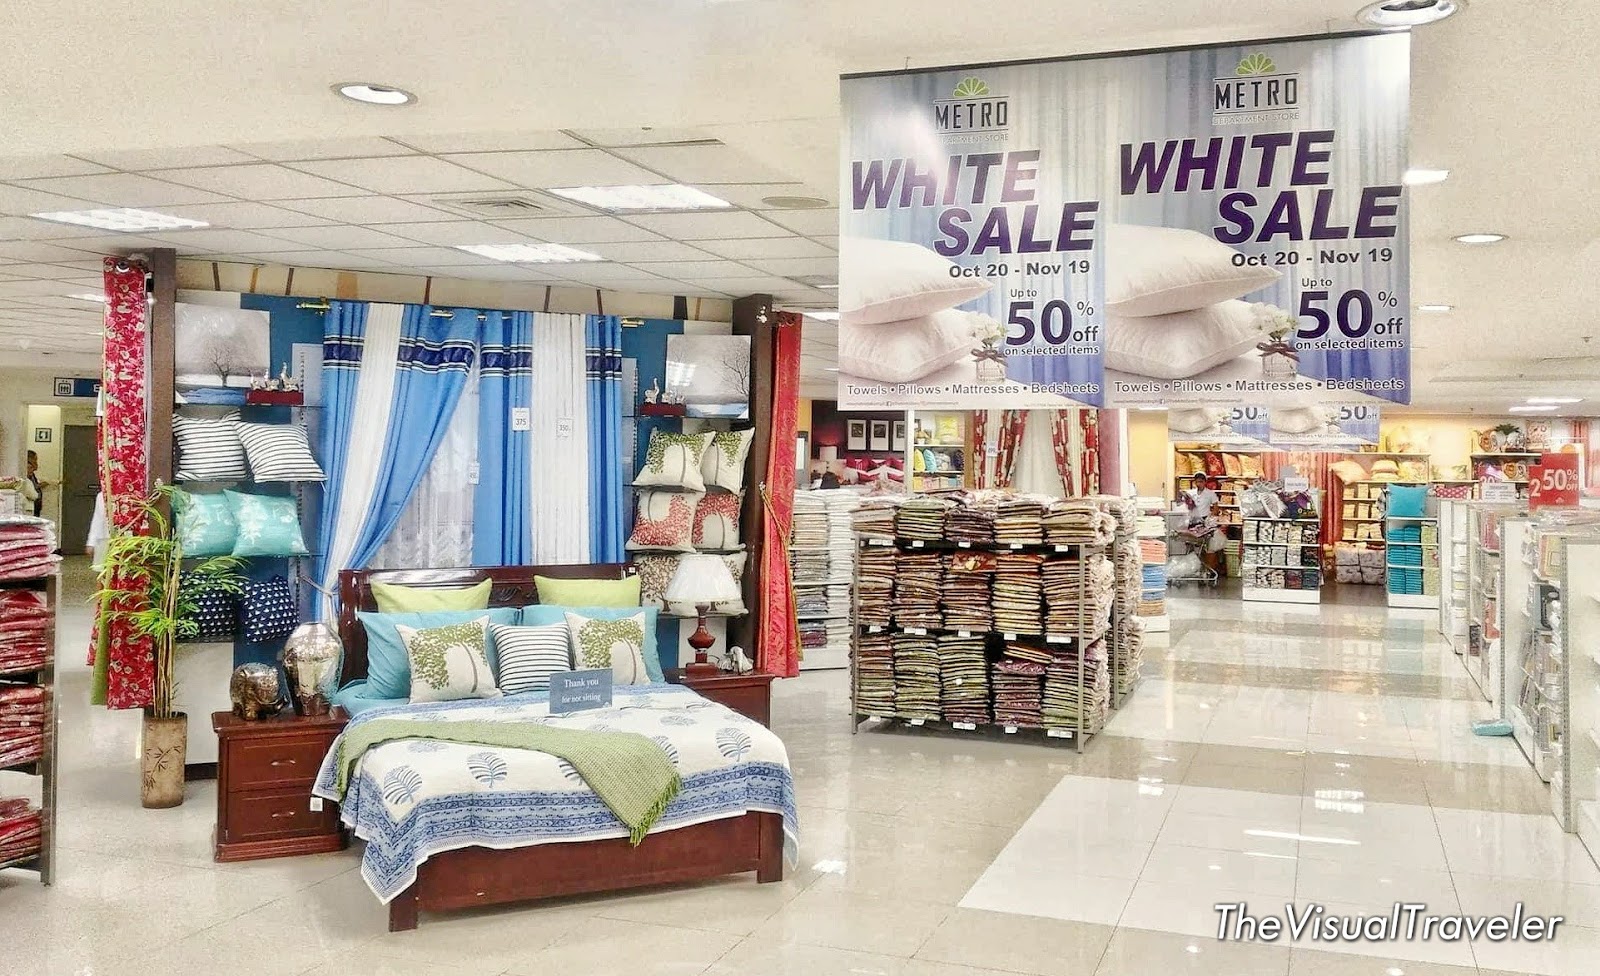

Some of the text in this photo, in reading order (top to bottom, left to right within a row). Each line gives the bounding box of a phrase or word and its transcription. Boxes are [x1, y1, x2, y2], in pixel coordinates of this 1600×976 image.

[1215, 78, 1297, 109] METRO
[935, 101, 1008, 130] METRO
[1273, 112, 1299, 121] STORE
[985, 133, 1009, 142] STORE
[1121, 130, 1335, 195] WHITE
[852, 150, 1040, 210] WHITE
[1213, 186, 1402, 244] SALE
[934, 201, 1099, 257] SALE
[1231, 252, 1267, 267] Oct
[1275, 251, 1299, 265] 20
[1320, 249, 1359, 264] Nov
[1367, 247, 1393, 262] 19
[950, 265, 980, 278] Oct
[987, 264, 1008, 277] 20
[1026, 262, 1061, 275] Nov
[1068, 260, 1090, 274] 19
[1302, 278, 1333, 288] Up to
[1010, 289, 1037, 298] Up to
[1072, 325, 1098, 342] off
[1373, 317, 1403, 335] off
[1004, 345, 1099, 356] on selected items
[1295, 338, 1404, 350] on selected items
[847, 382, 1099, 395] Towels Pillows Mattresses Bedsheets
[1114, 378, 1404, 392] Towels Pillows Mattresses Bedsheets
[564, 677, 599, 689] Thank you
